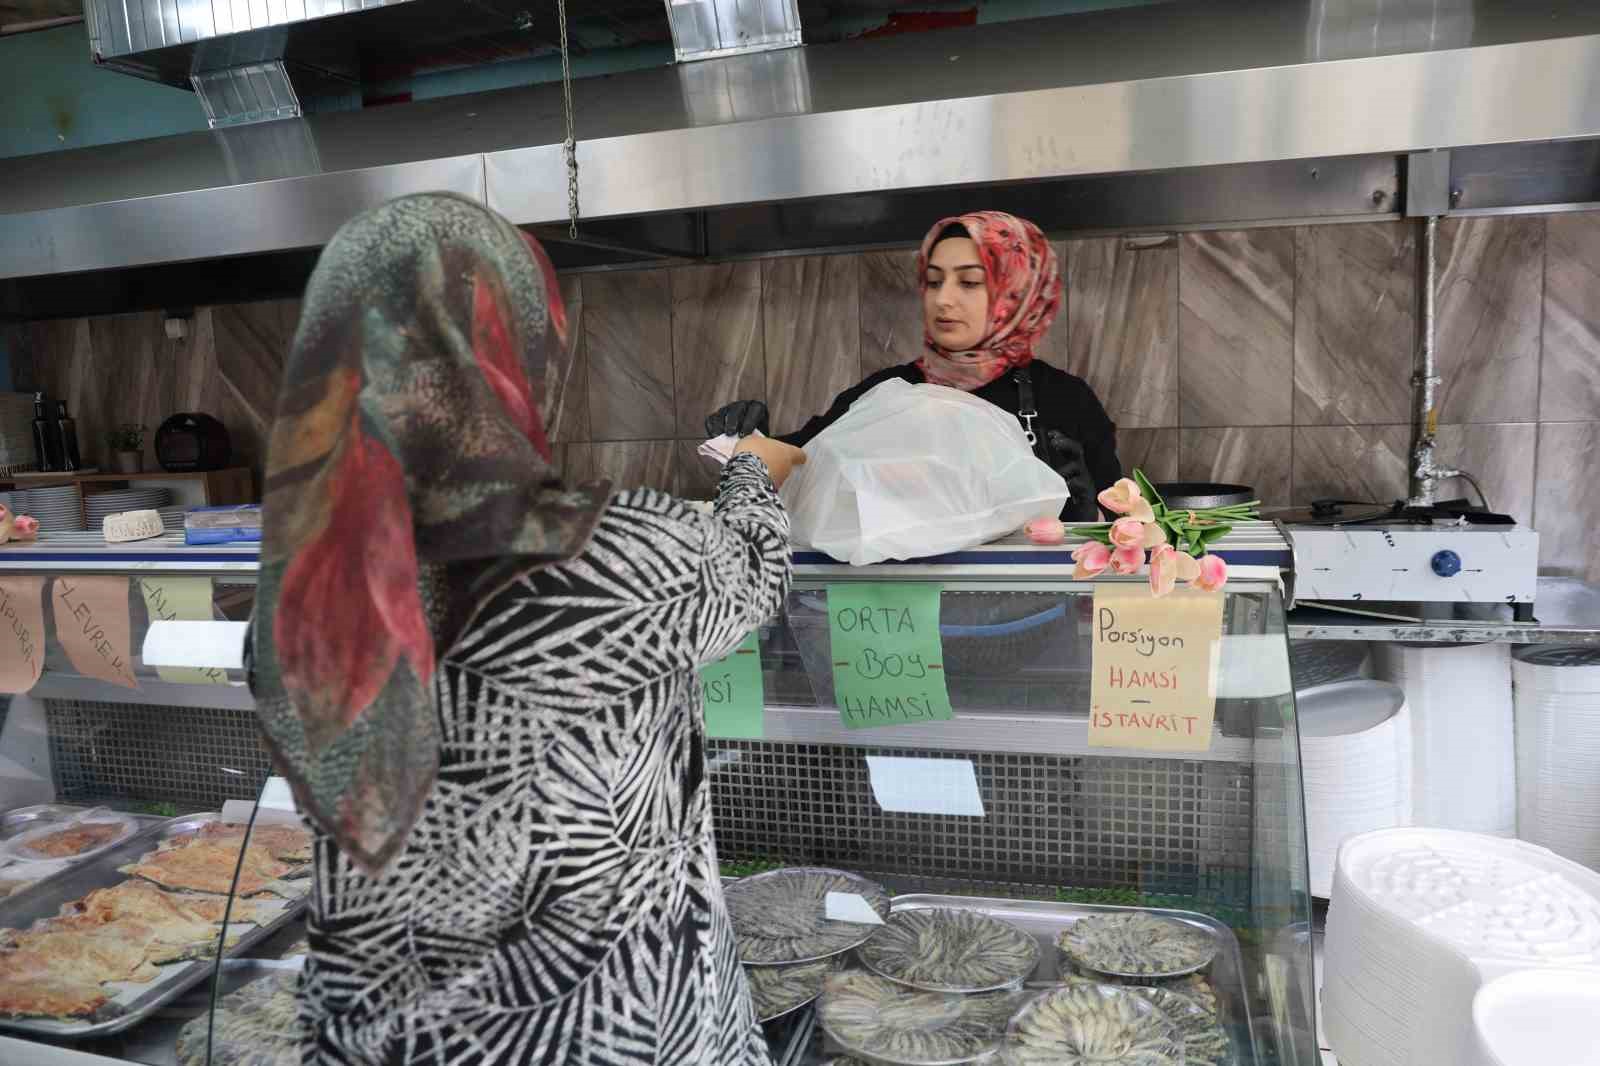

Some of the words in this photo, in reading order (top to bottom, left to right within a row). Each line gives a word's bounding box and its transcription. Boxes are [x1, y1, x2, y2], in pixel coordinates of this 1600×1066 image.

[836, 606, 915, 633] ORTA
[1098, 607, 1184, 656] Porsiyon
[855, 648, 926, 679] BOY
[1109, 665, 1177, 689] HAMSİ
[844, 692, 935, 720] HAMSİ
